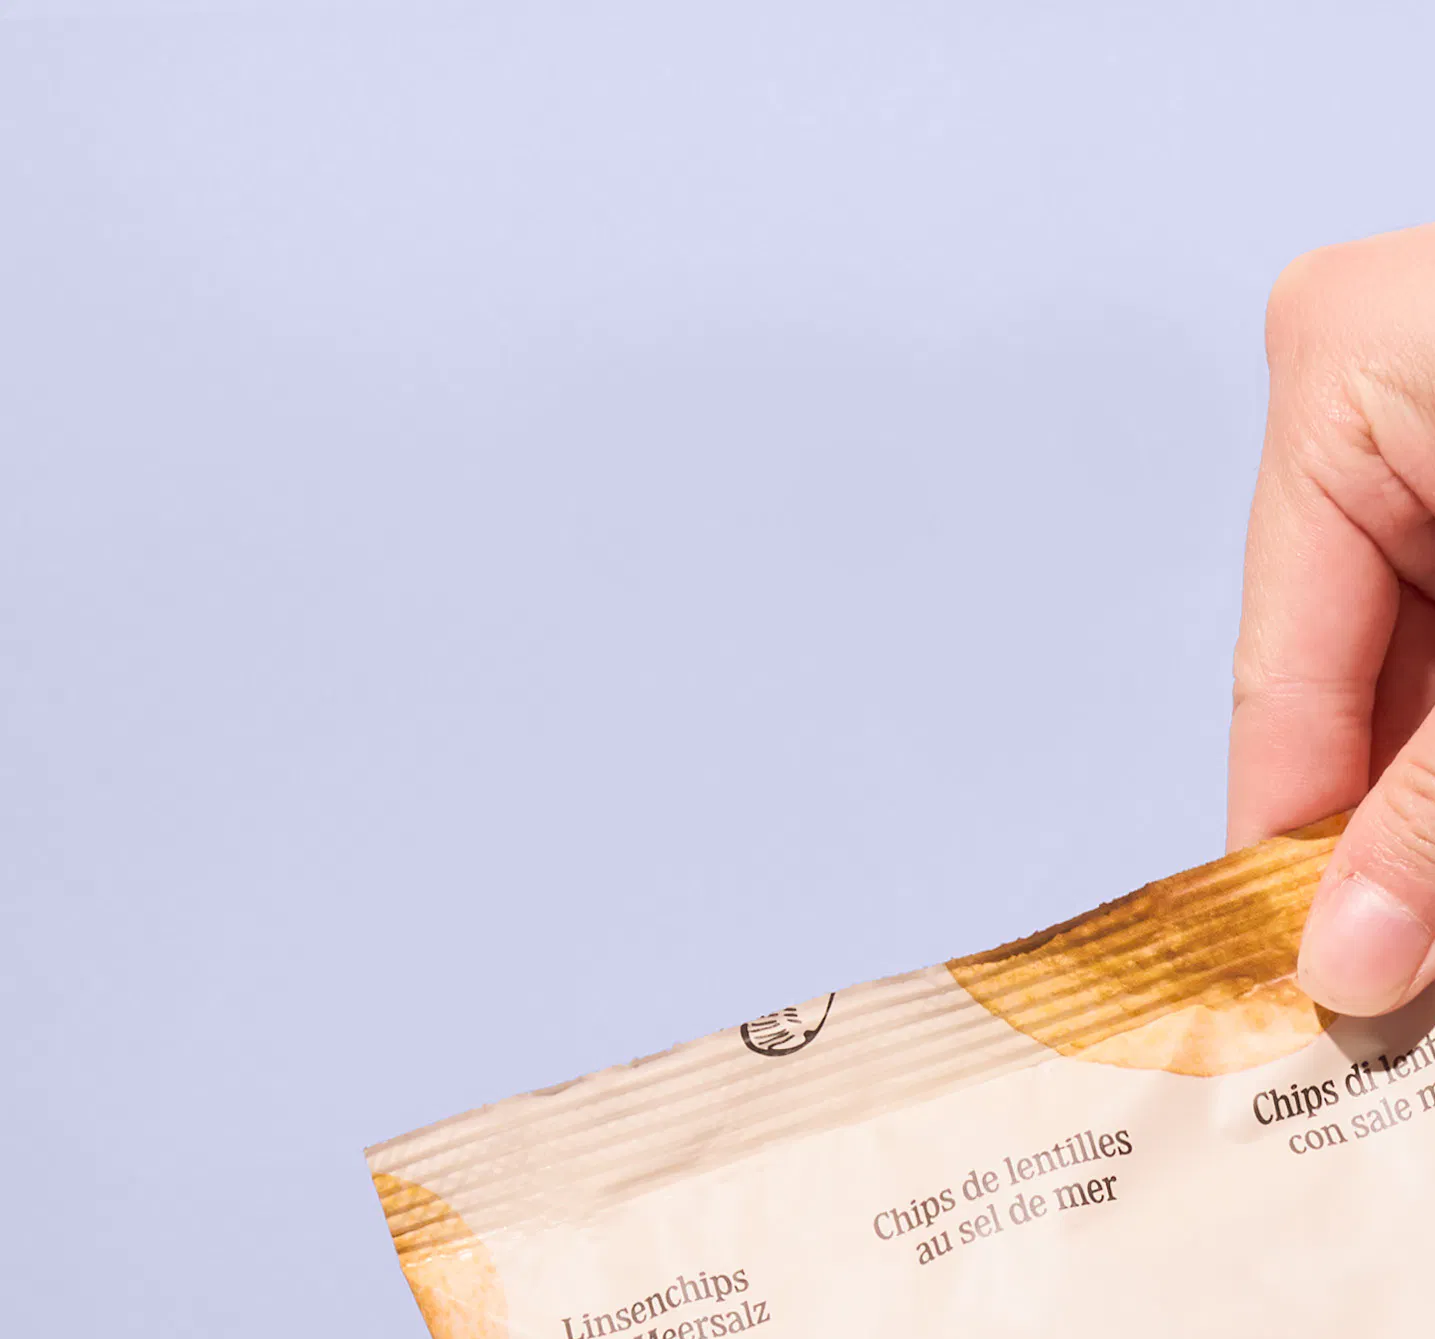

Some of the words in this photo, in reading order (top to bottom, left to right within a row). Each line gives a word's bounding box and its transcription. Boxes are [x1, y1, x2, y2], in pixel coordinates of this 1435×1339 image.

[1252, 1078, 1339, 1125] Chips
[1345, 1060, 1379, 1097] di
[1288, 1121, 1348, 1155] con
[1350, 1096, 1413, 1139] sale
[873, 1188, 956, 1241] Chips
[962, 1169, 999, 1201] de
[1002, 1129, 1133, 1186] lentilles
[915, 1230, 953, 1265] au
[957, 1203, 1004, 1245] sel
[1008, 1193, 1047, 1225] de
[1052, 1175, 1117, 1211] mer
